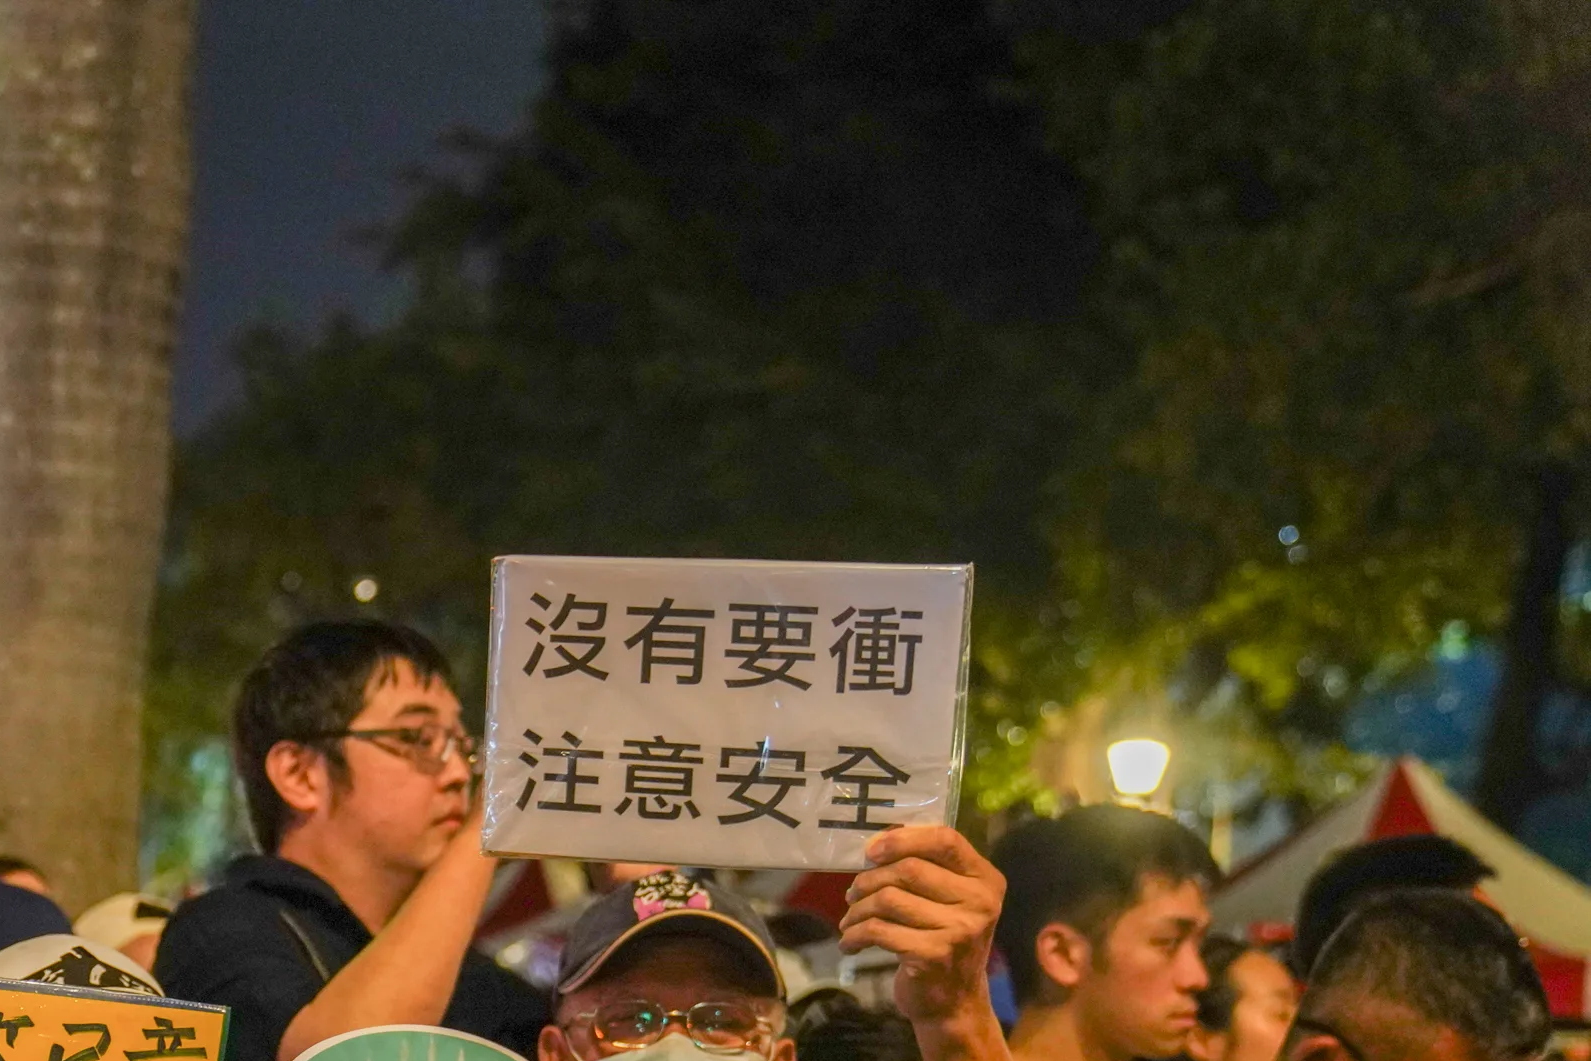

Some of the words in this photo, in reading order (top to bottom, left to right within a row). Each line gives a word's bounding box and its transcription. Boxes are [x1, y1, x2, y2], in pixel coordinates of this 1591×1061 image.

[522, 592, 924, 696] 沒有要衝
[515, 728, 911, 831] 注意安全
